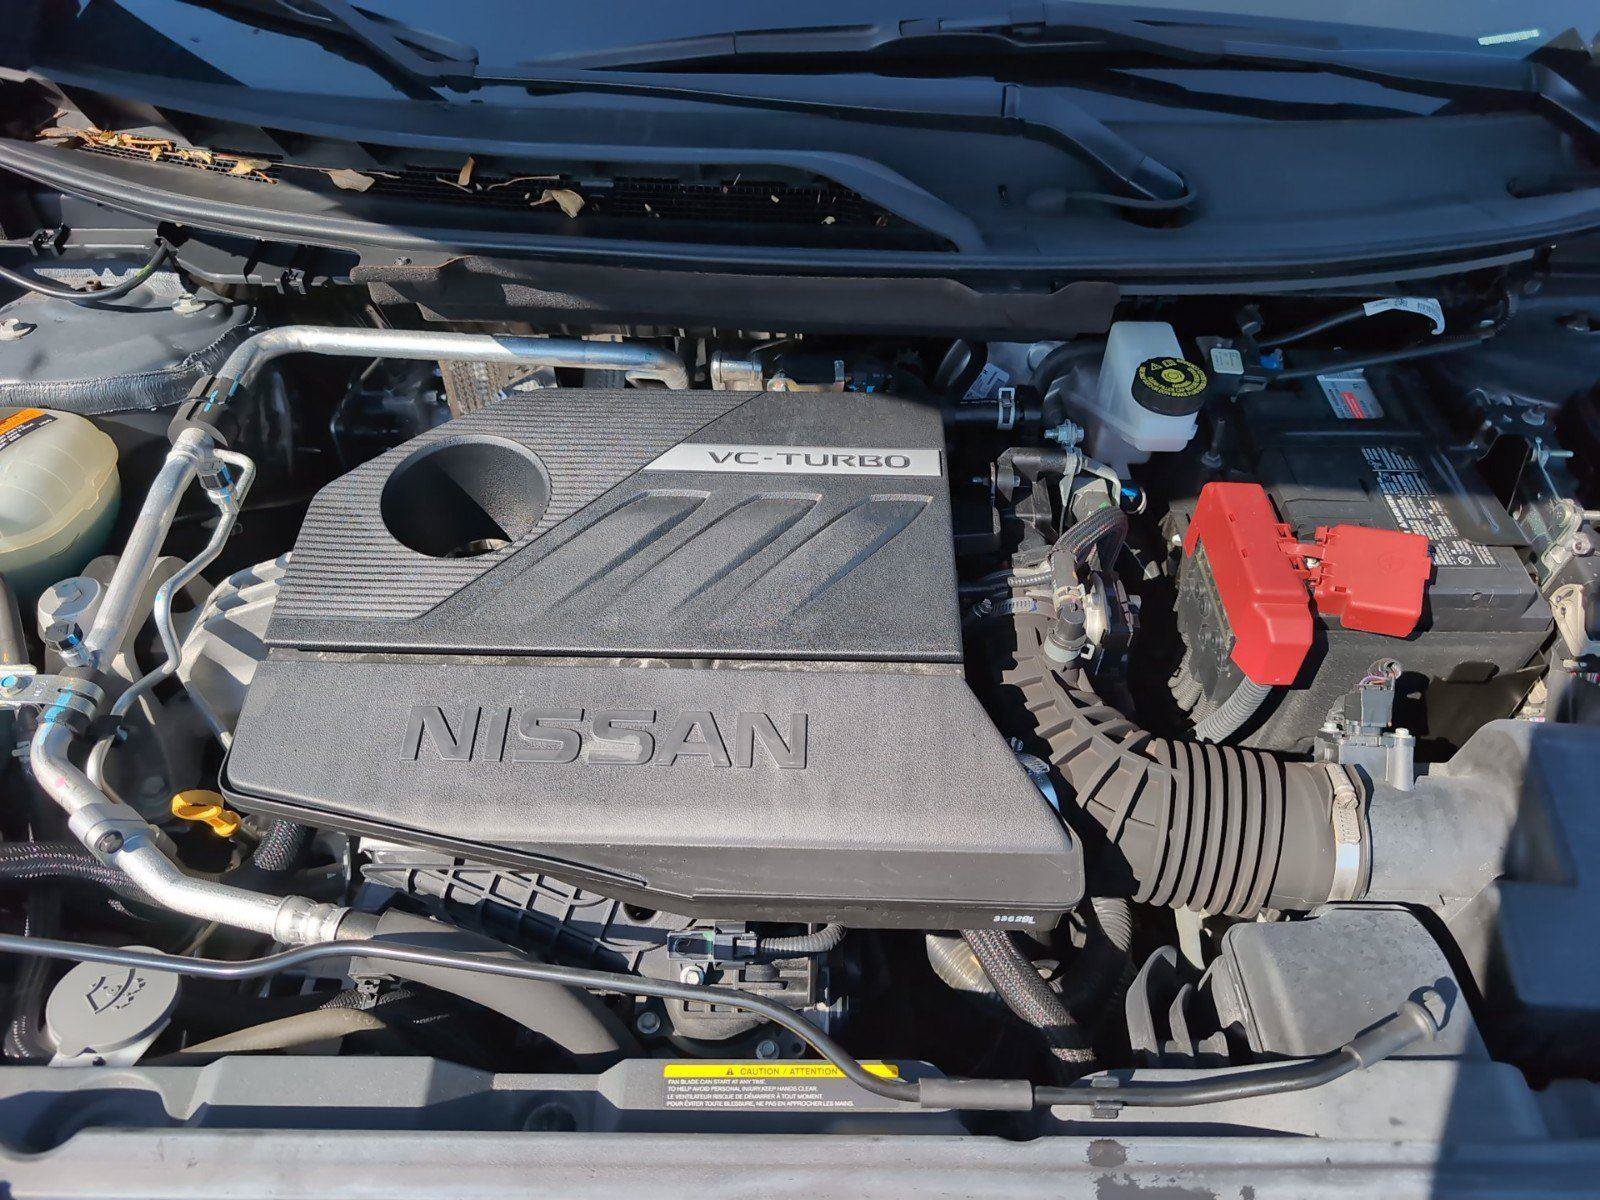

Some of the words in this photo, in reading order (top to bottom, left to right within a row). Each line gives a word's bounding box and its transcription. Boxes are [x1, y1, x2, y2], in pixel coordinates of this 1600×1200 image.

[707, 450, 911, 469] VC-TURBO
[400, 706, 808, 769] NISSAN
[740, 1067, 779, 1075] CAUTION
[790, 1067, 838, 1075] ATTENTION
